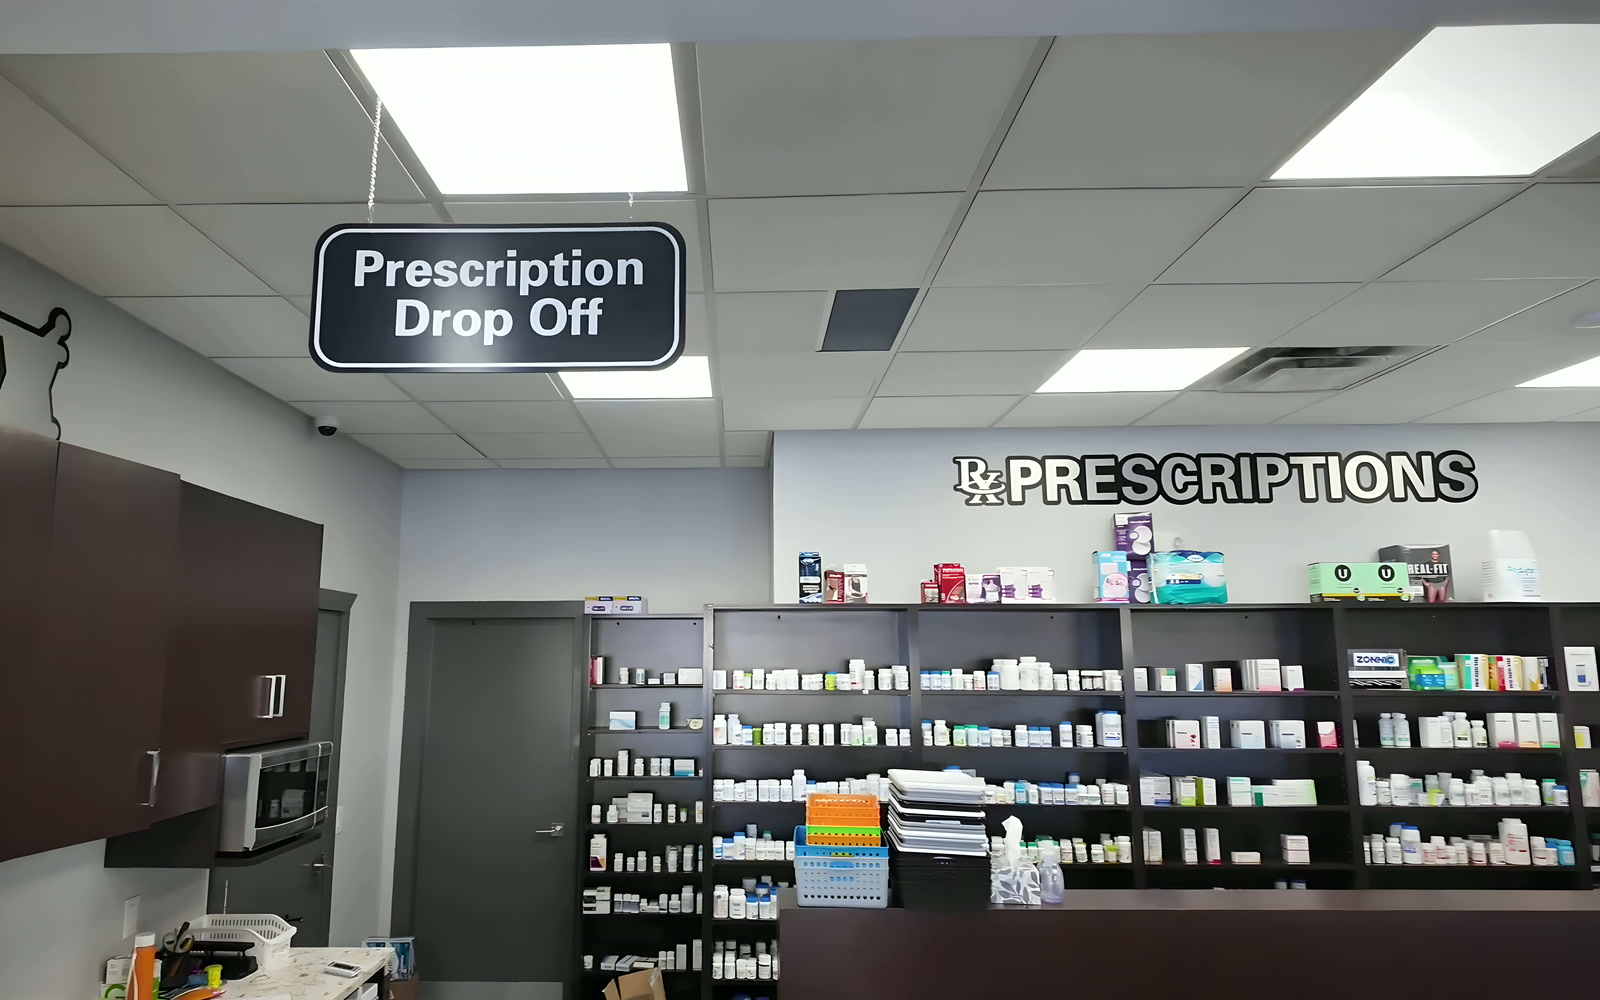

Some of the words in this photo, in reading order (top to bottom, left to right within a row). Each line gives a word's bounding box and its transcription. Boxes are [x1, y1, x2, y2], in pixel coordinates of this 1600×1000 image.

[354, 249, 644, 296] Prescription
[394, 298, 514, 346] Drop
[529, 297, 604, 337] Off
[1007, 452, 1478, 502] PRESCRIPTIONS
